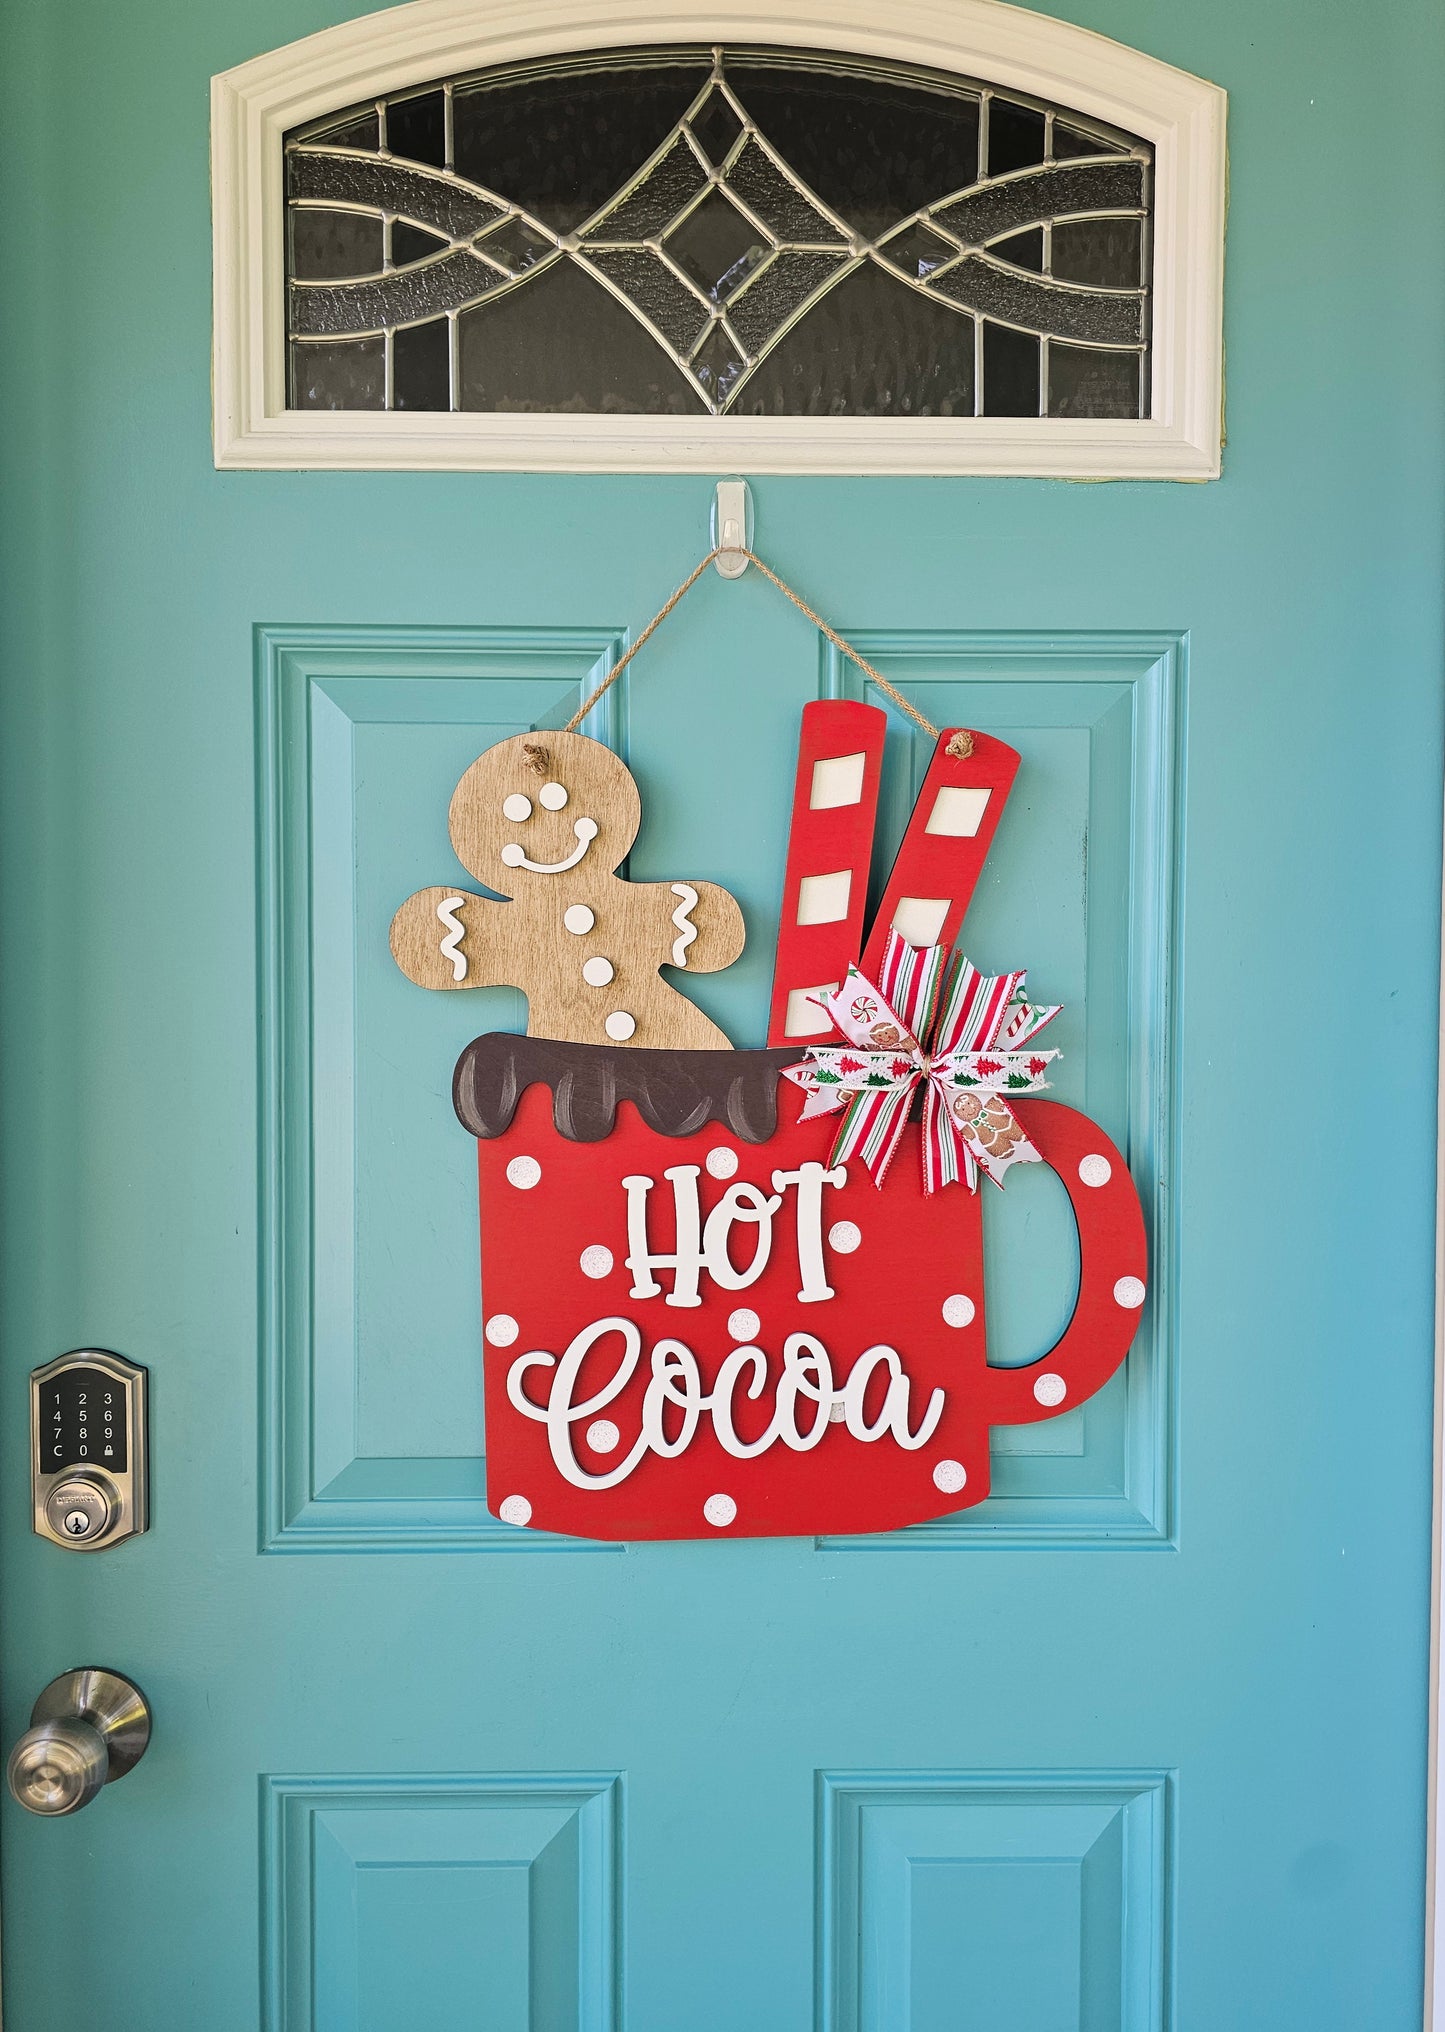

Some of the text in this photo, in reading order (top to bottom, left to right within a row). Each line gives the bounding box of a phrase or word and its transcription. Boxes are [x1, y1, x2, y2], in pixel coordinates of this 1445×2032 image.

[54, 1393, 113, 1405] 1 2 3
[506, 1316, 946, 1491] Cocoa
[53, 1410, 113, 1422] 4 5 6
[54, 1427, 113, 1440] 7 8 9
[53, 1444, 88, 1457] C 0
